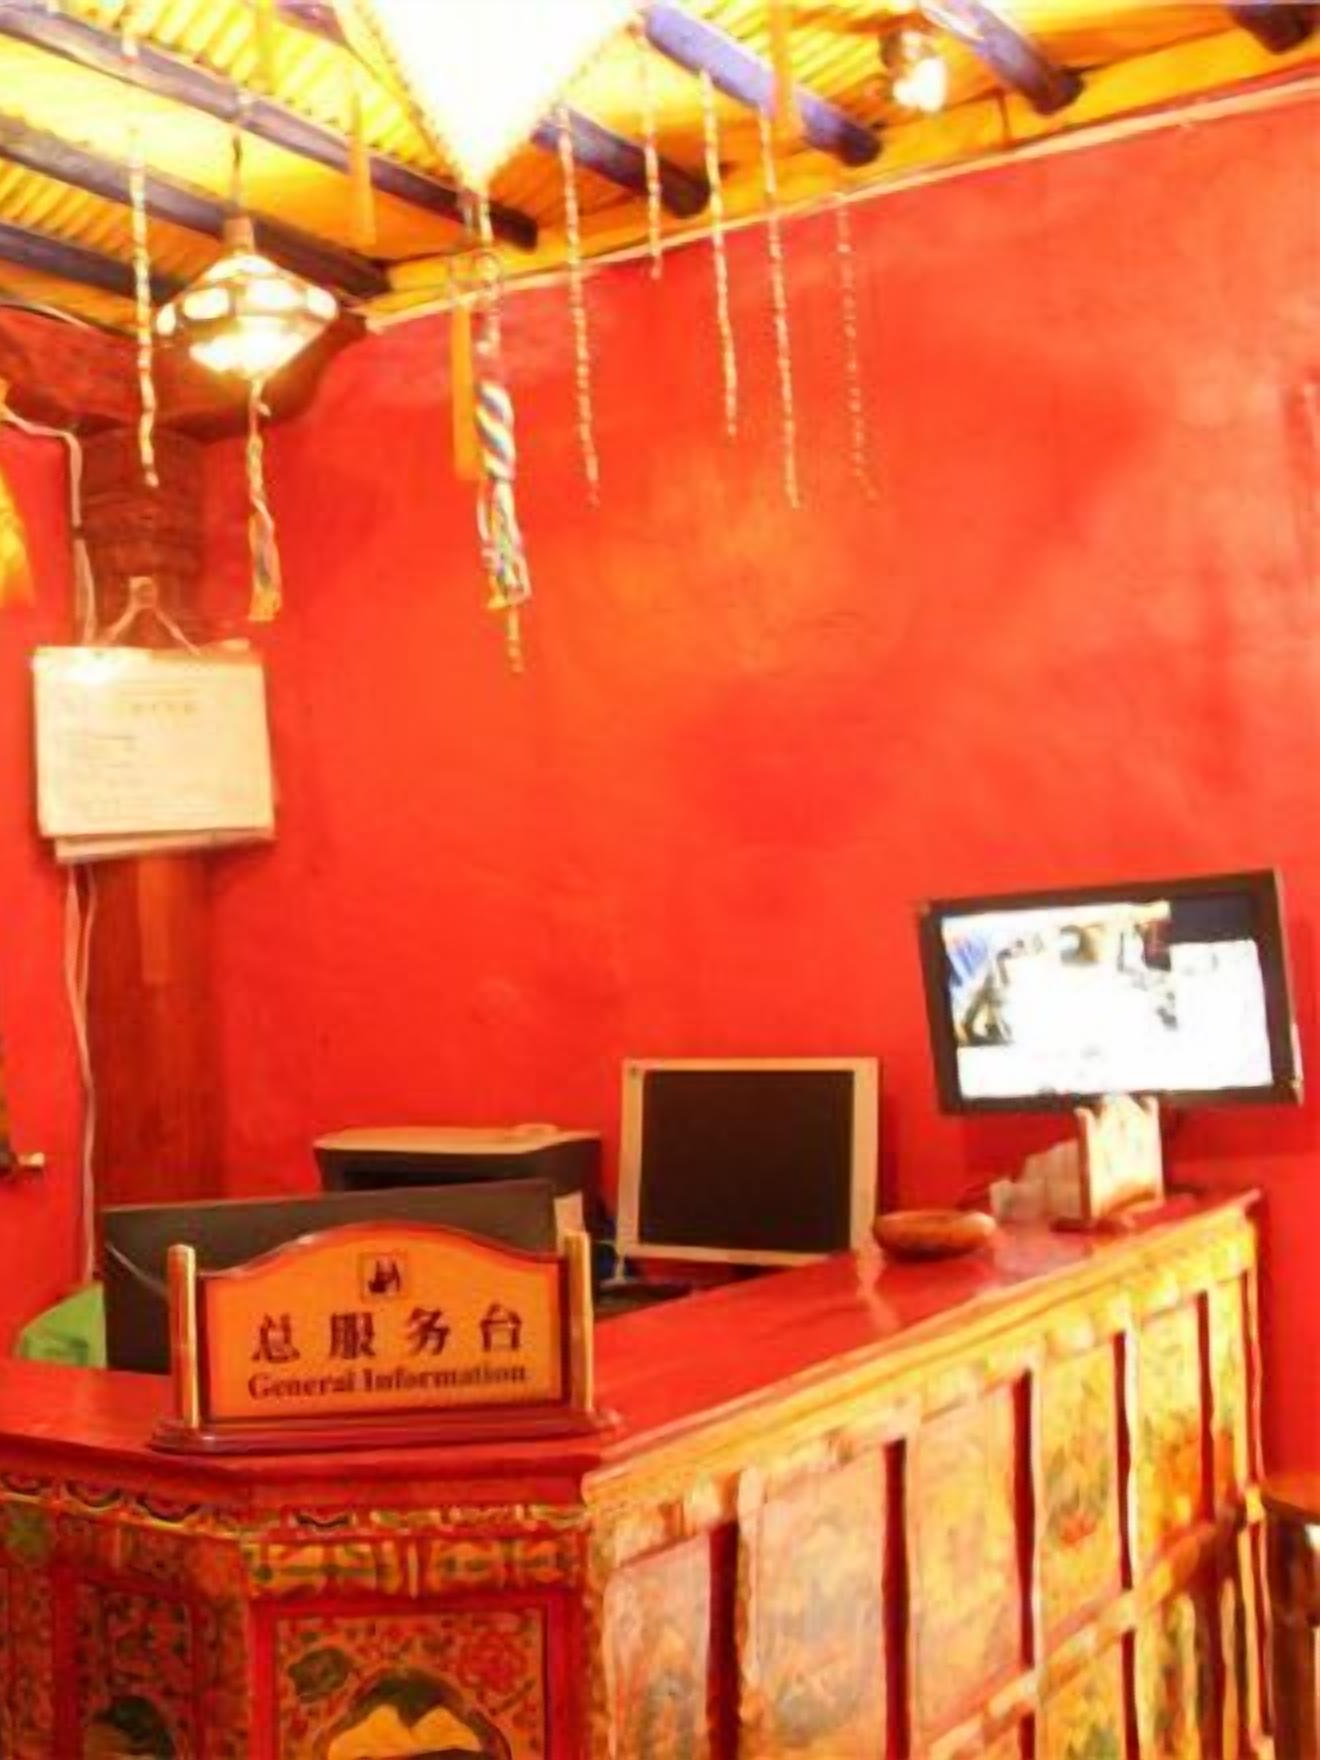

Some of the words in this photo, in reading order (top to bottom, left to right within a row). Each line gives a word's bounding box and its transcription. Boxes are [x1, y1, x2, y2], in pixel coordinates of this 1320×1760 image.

[251, 1302, 523, 1363] 总服务台
[248, 1369, 355, 1400] General
[363, 1364, 526, 1393] Information
